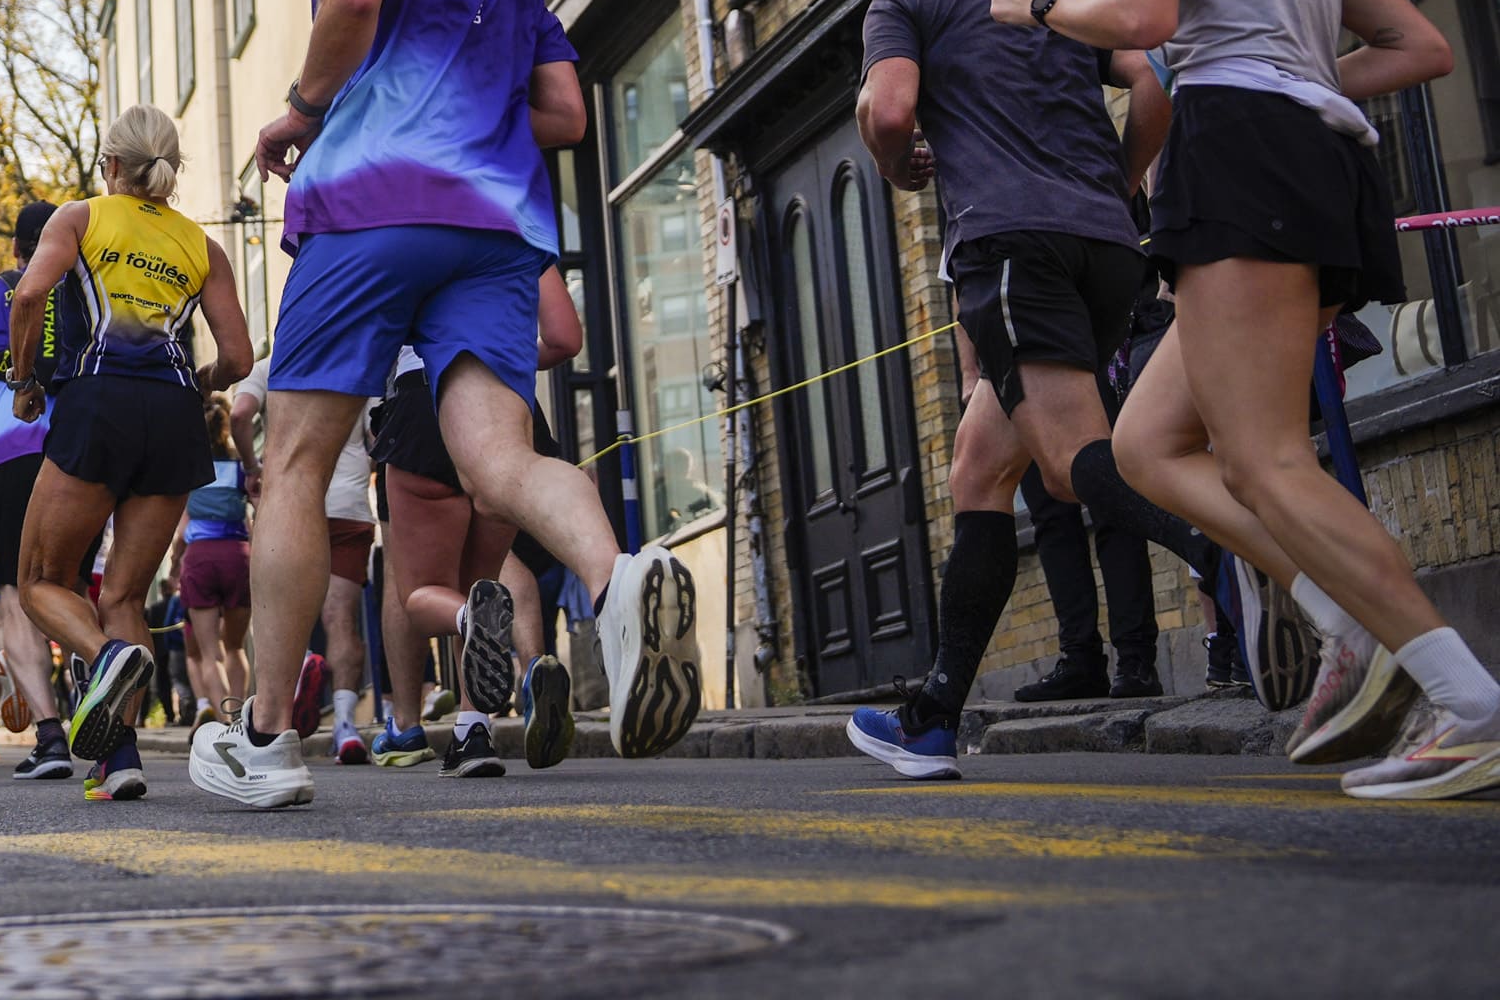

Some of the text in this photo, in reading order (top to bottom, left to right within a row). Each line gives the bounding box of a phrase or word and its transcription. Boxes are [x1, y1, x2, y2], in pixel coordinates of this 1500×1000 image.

[138, 251, 163, 262] CLUB
[100, 248, 189, 286] la foulée
[110, 292, 134, 301] sports
